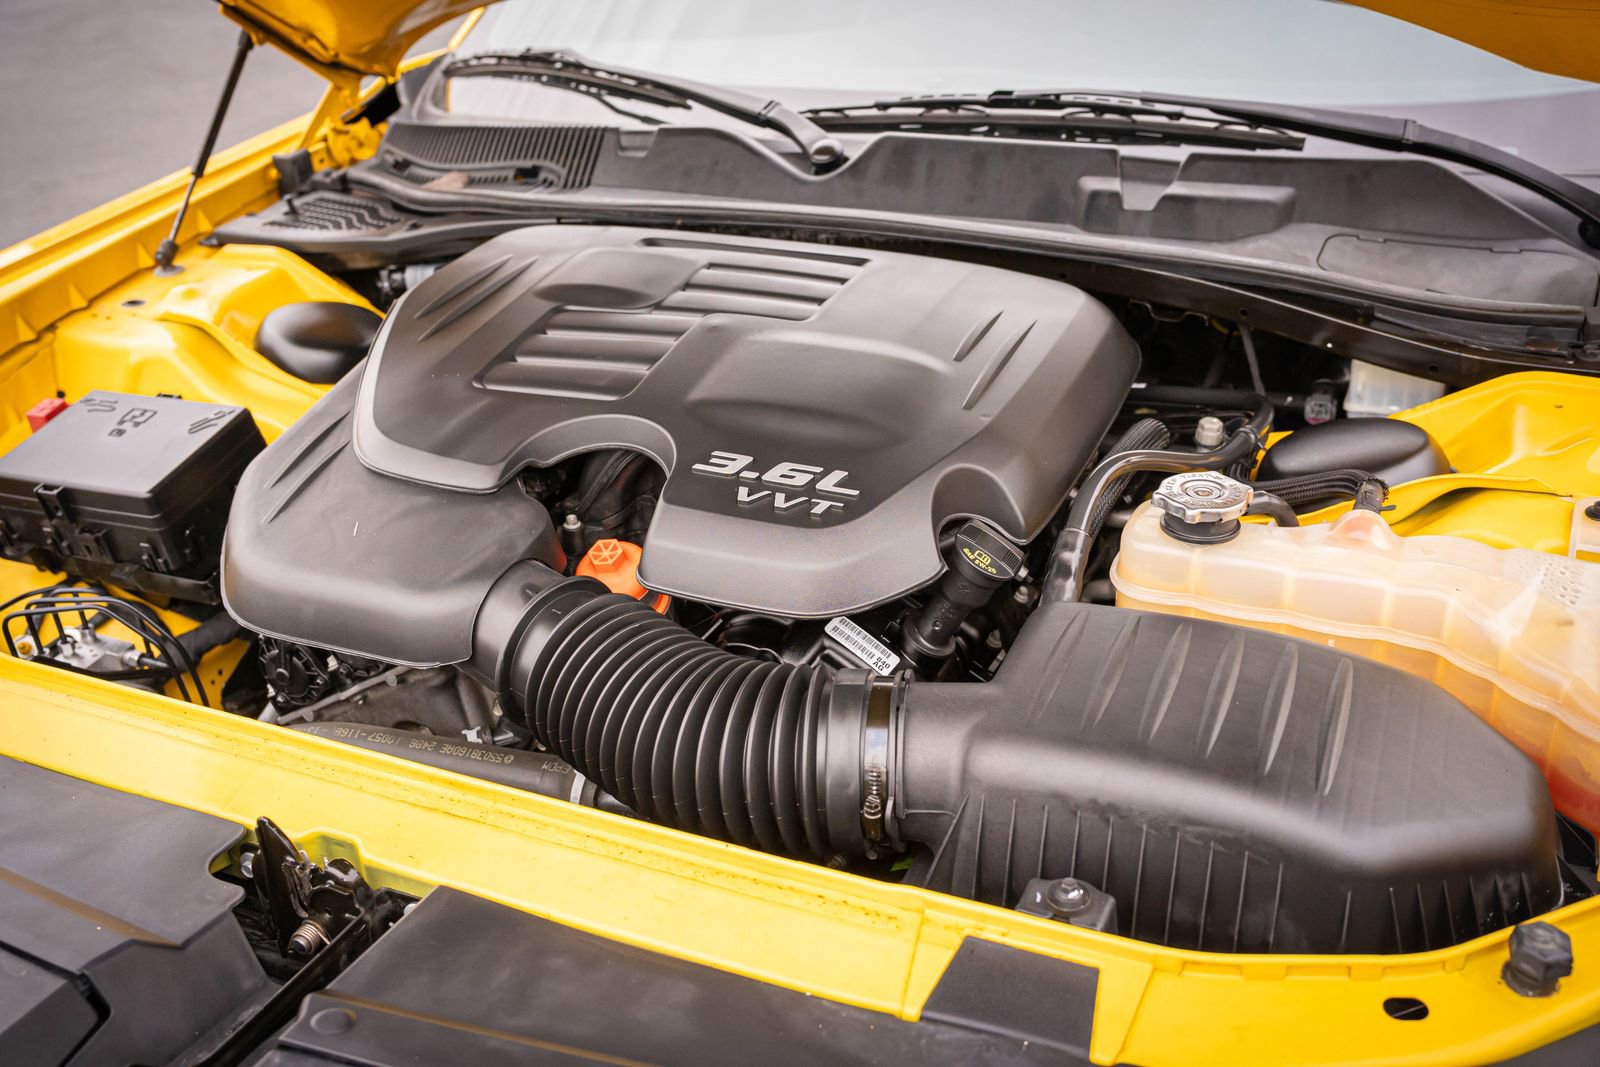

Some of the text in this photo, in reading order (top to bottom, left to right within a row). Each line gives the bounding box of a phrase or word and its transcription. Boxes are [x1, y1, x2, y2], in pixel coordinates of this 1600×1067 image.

[691, 450, 861, 498] 3.6L
[737, 486, 845, 518] VVT
[872, 660, 885, 672] AG
[876, 656, 891, 670] 840
